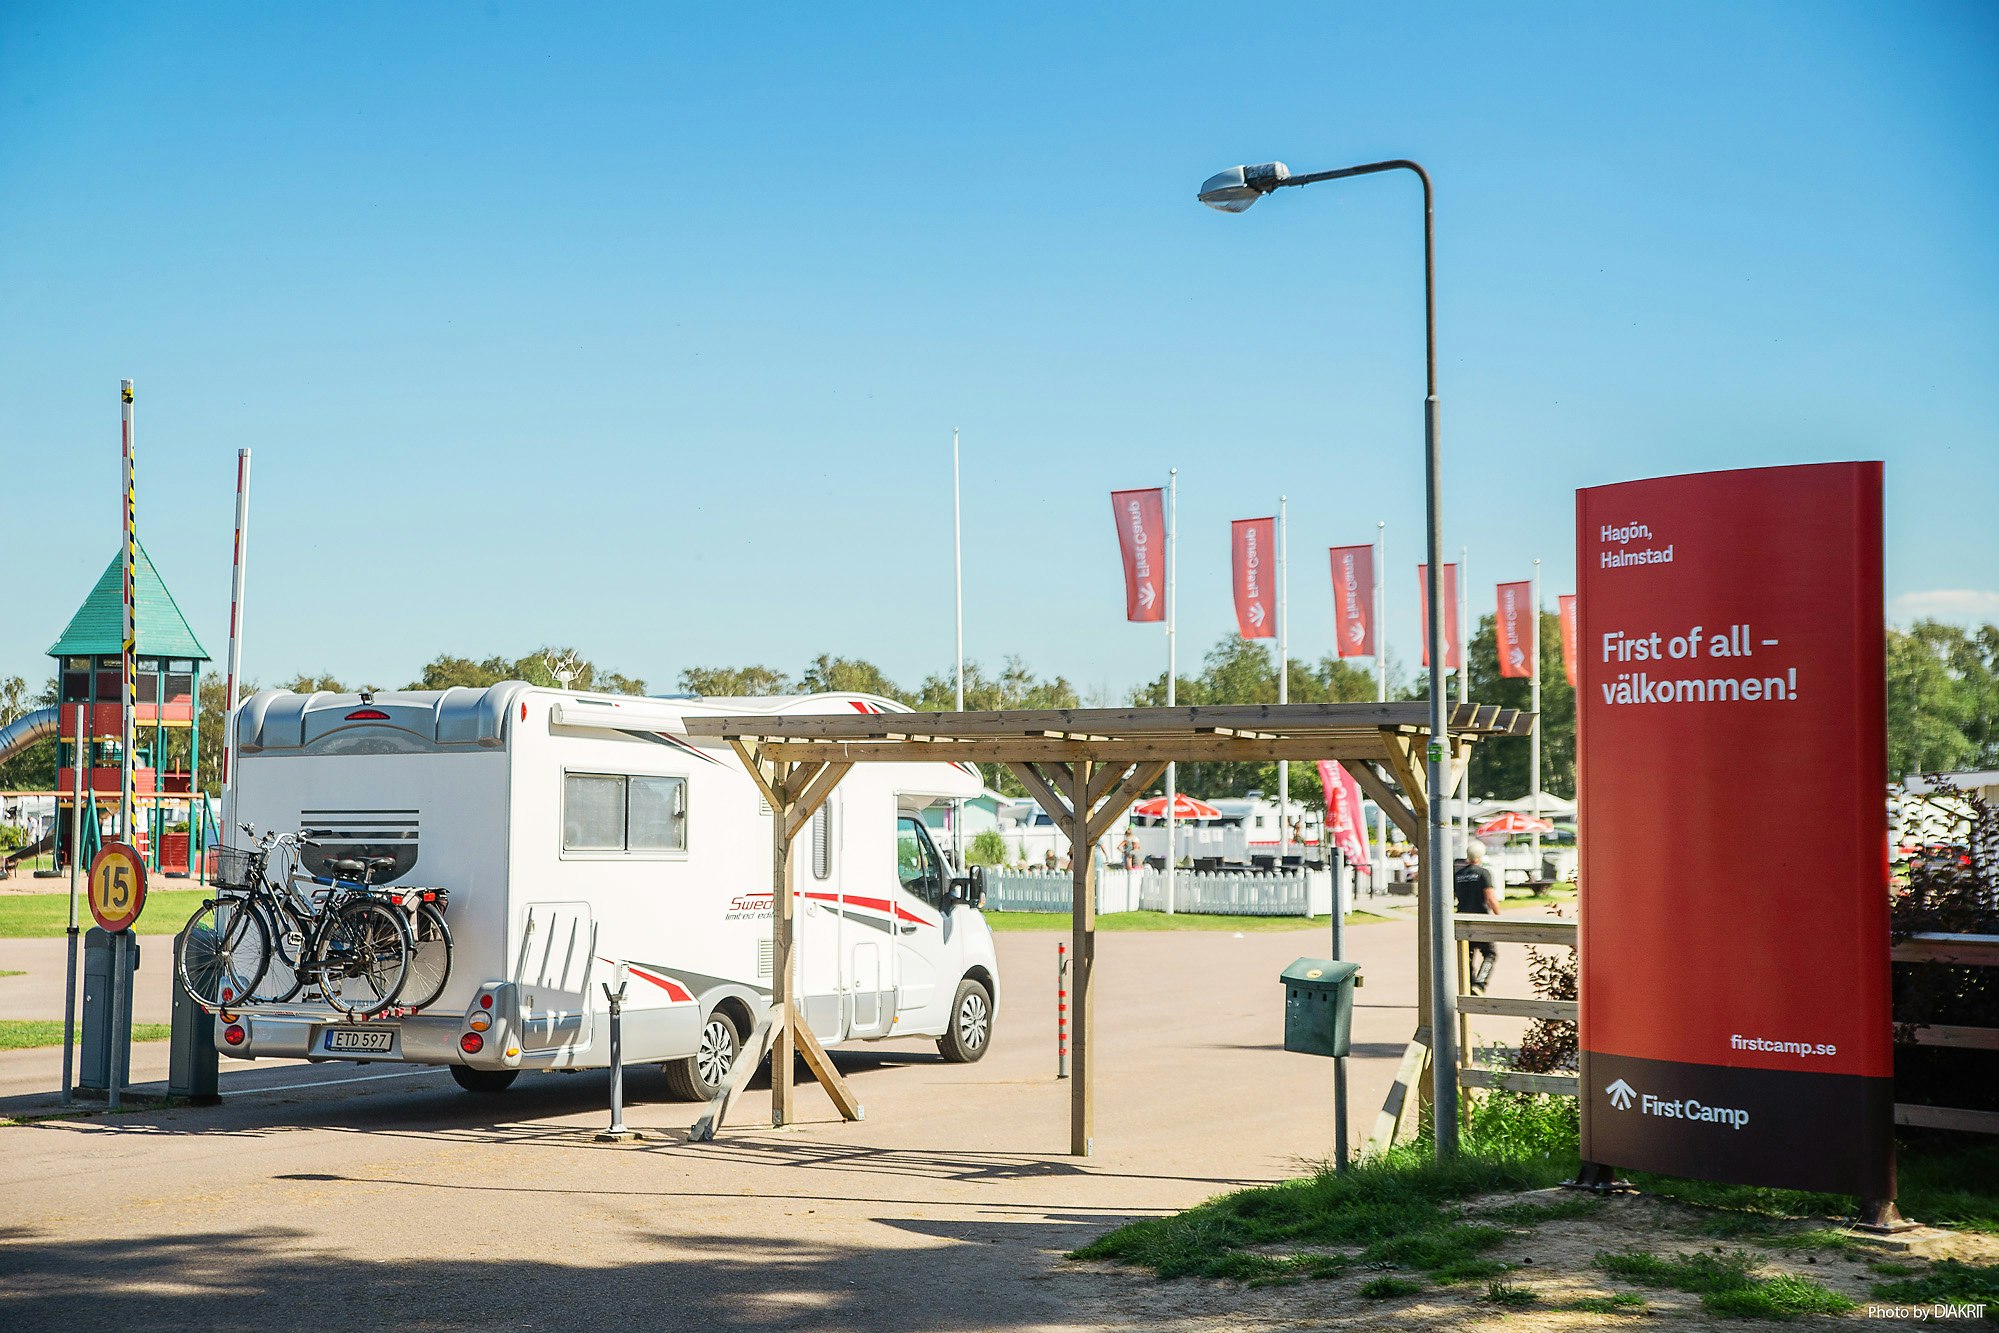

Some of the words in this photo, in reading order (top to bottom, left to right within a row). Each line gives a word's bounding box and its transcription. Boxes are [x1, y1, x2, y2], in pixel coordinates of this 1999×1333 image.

[1600, 521, 1653, 544] Hagön,
[1600, 545, 1674, 569] Halmstad
[1602, 630, 1663, 663] First
[1667, 625, 1703, 660] of
[1708, 623, 1753, 658] all
[1601, 667, 1798, 705] välkommen!
[102, 865, 129, 908] 15
[728, 896, 775, 911] Swed
[336, 1033, 359, 1047] ETD
[362, 1033, 387, 1048] 597
[1730, 1033, 1837, 1058] firstcamp.se
